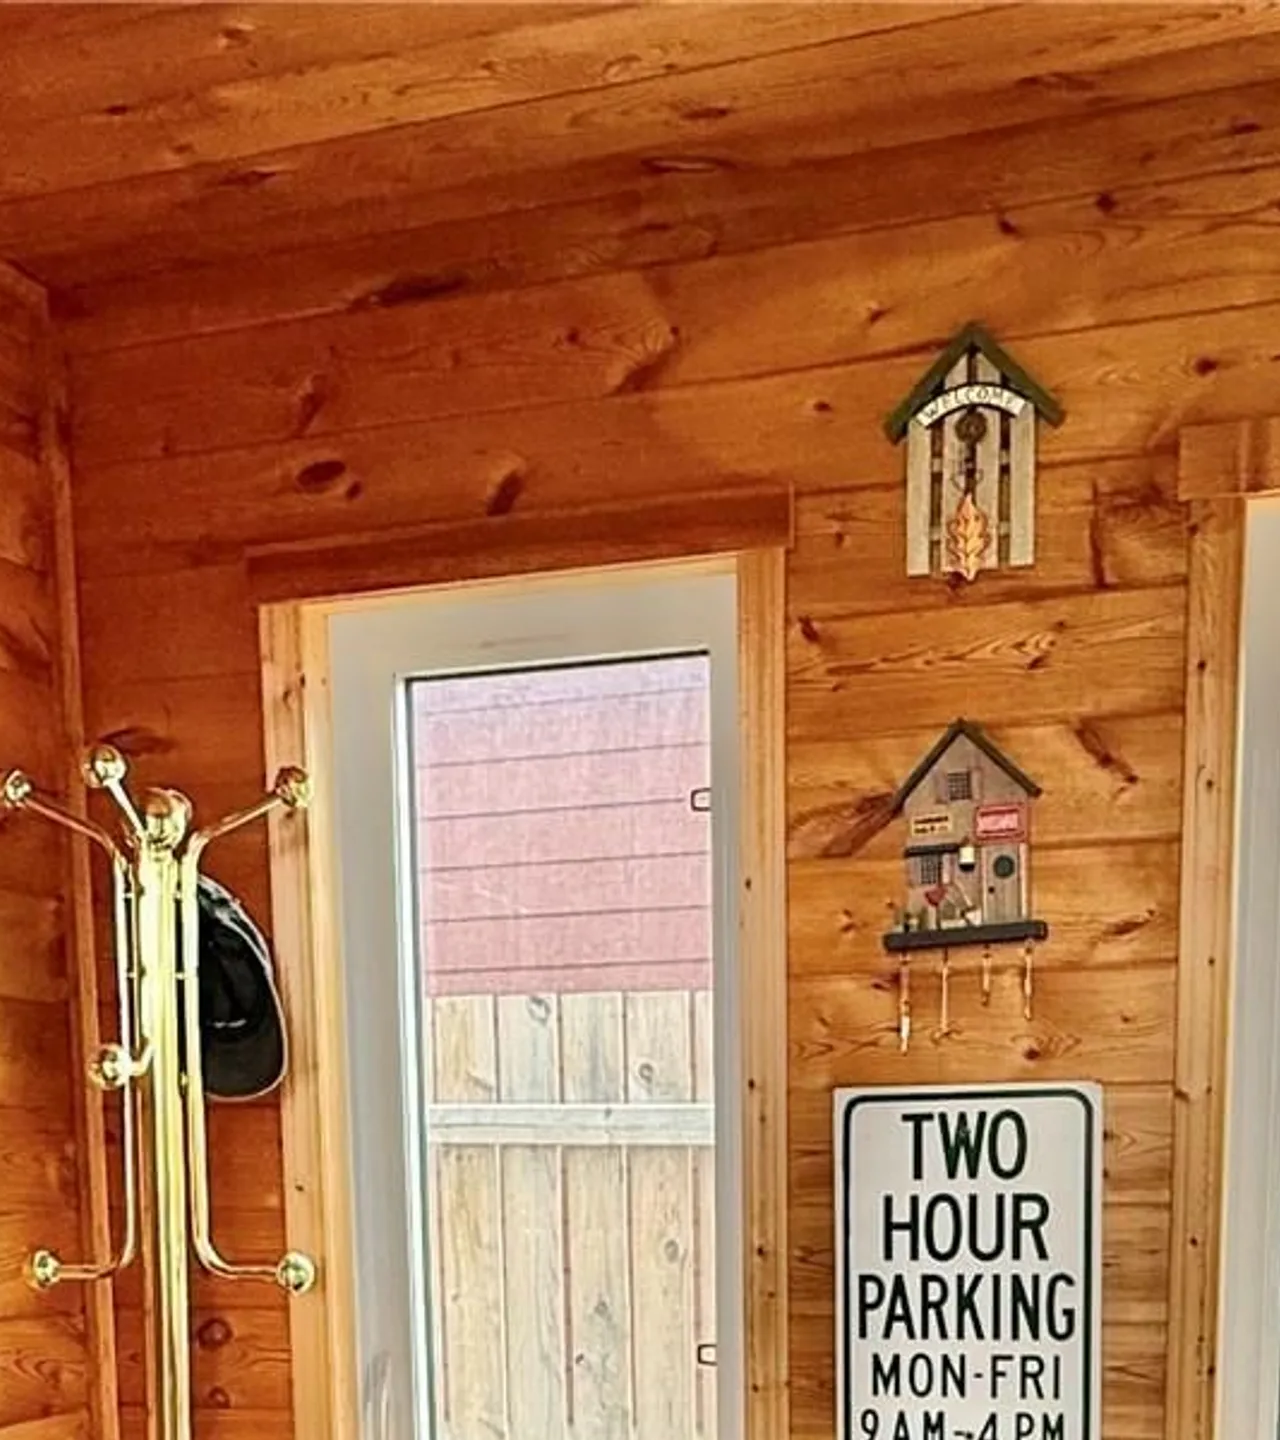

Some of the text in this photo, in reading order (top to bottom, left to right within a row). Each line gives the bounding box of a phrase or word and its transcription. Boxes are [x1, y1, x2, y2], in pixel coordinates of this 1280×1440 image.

[923, 386, 1017, 420] WELCOME
[901, 1109, 1029, 1181] TWO
[883, 1193, 1050, 1262] HOUR
[858, 1272, 1076, 1342] PARKING
[871, 1352, 1062, 1400] MON-FRI
